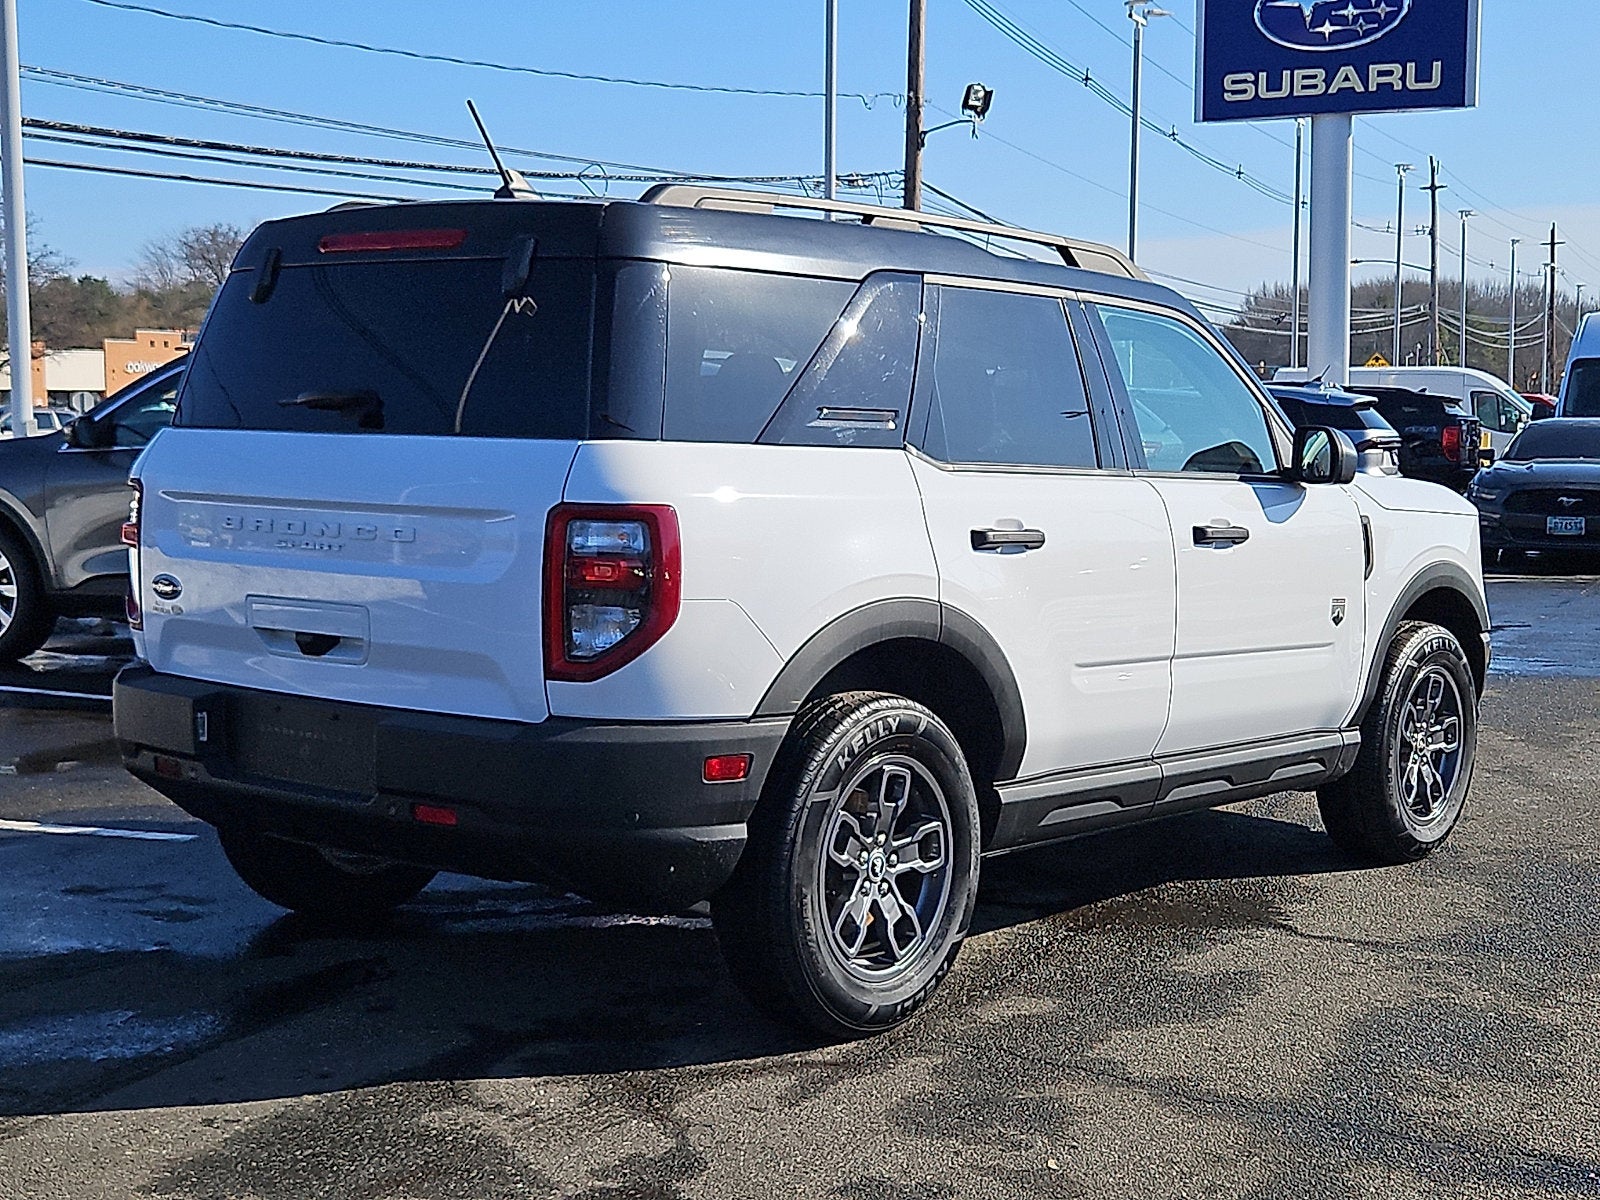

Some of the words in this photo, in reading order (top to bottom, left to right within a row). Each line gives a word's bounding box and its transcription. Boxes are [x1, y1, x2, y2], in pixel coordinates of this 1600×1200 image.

[1223, 60, 1442, 101] SUBARU
[222, 514, 417, 544] BRONCO
[274, 538, 346, 552] SPORT
[1424, 638, 1456, 656] KELLY
[838, 714, 902, 771] KELLY
